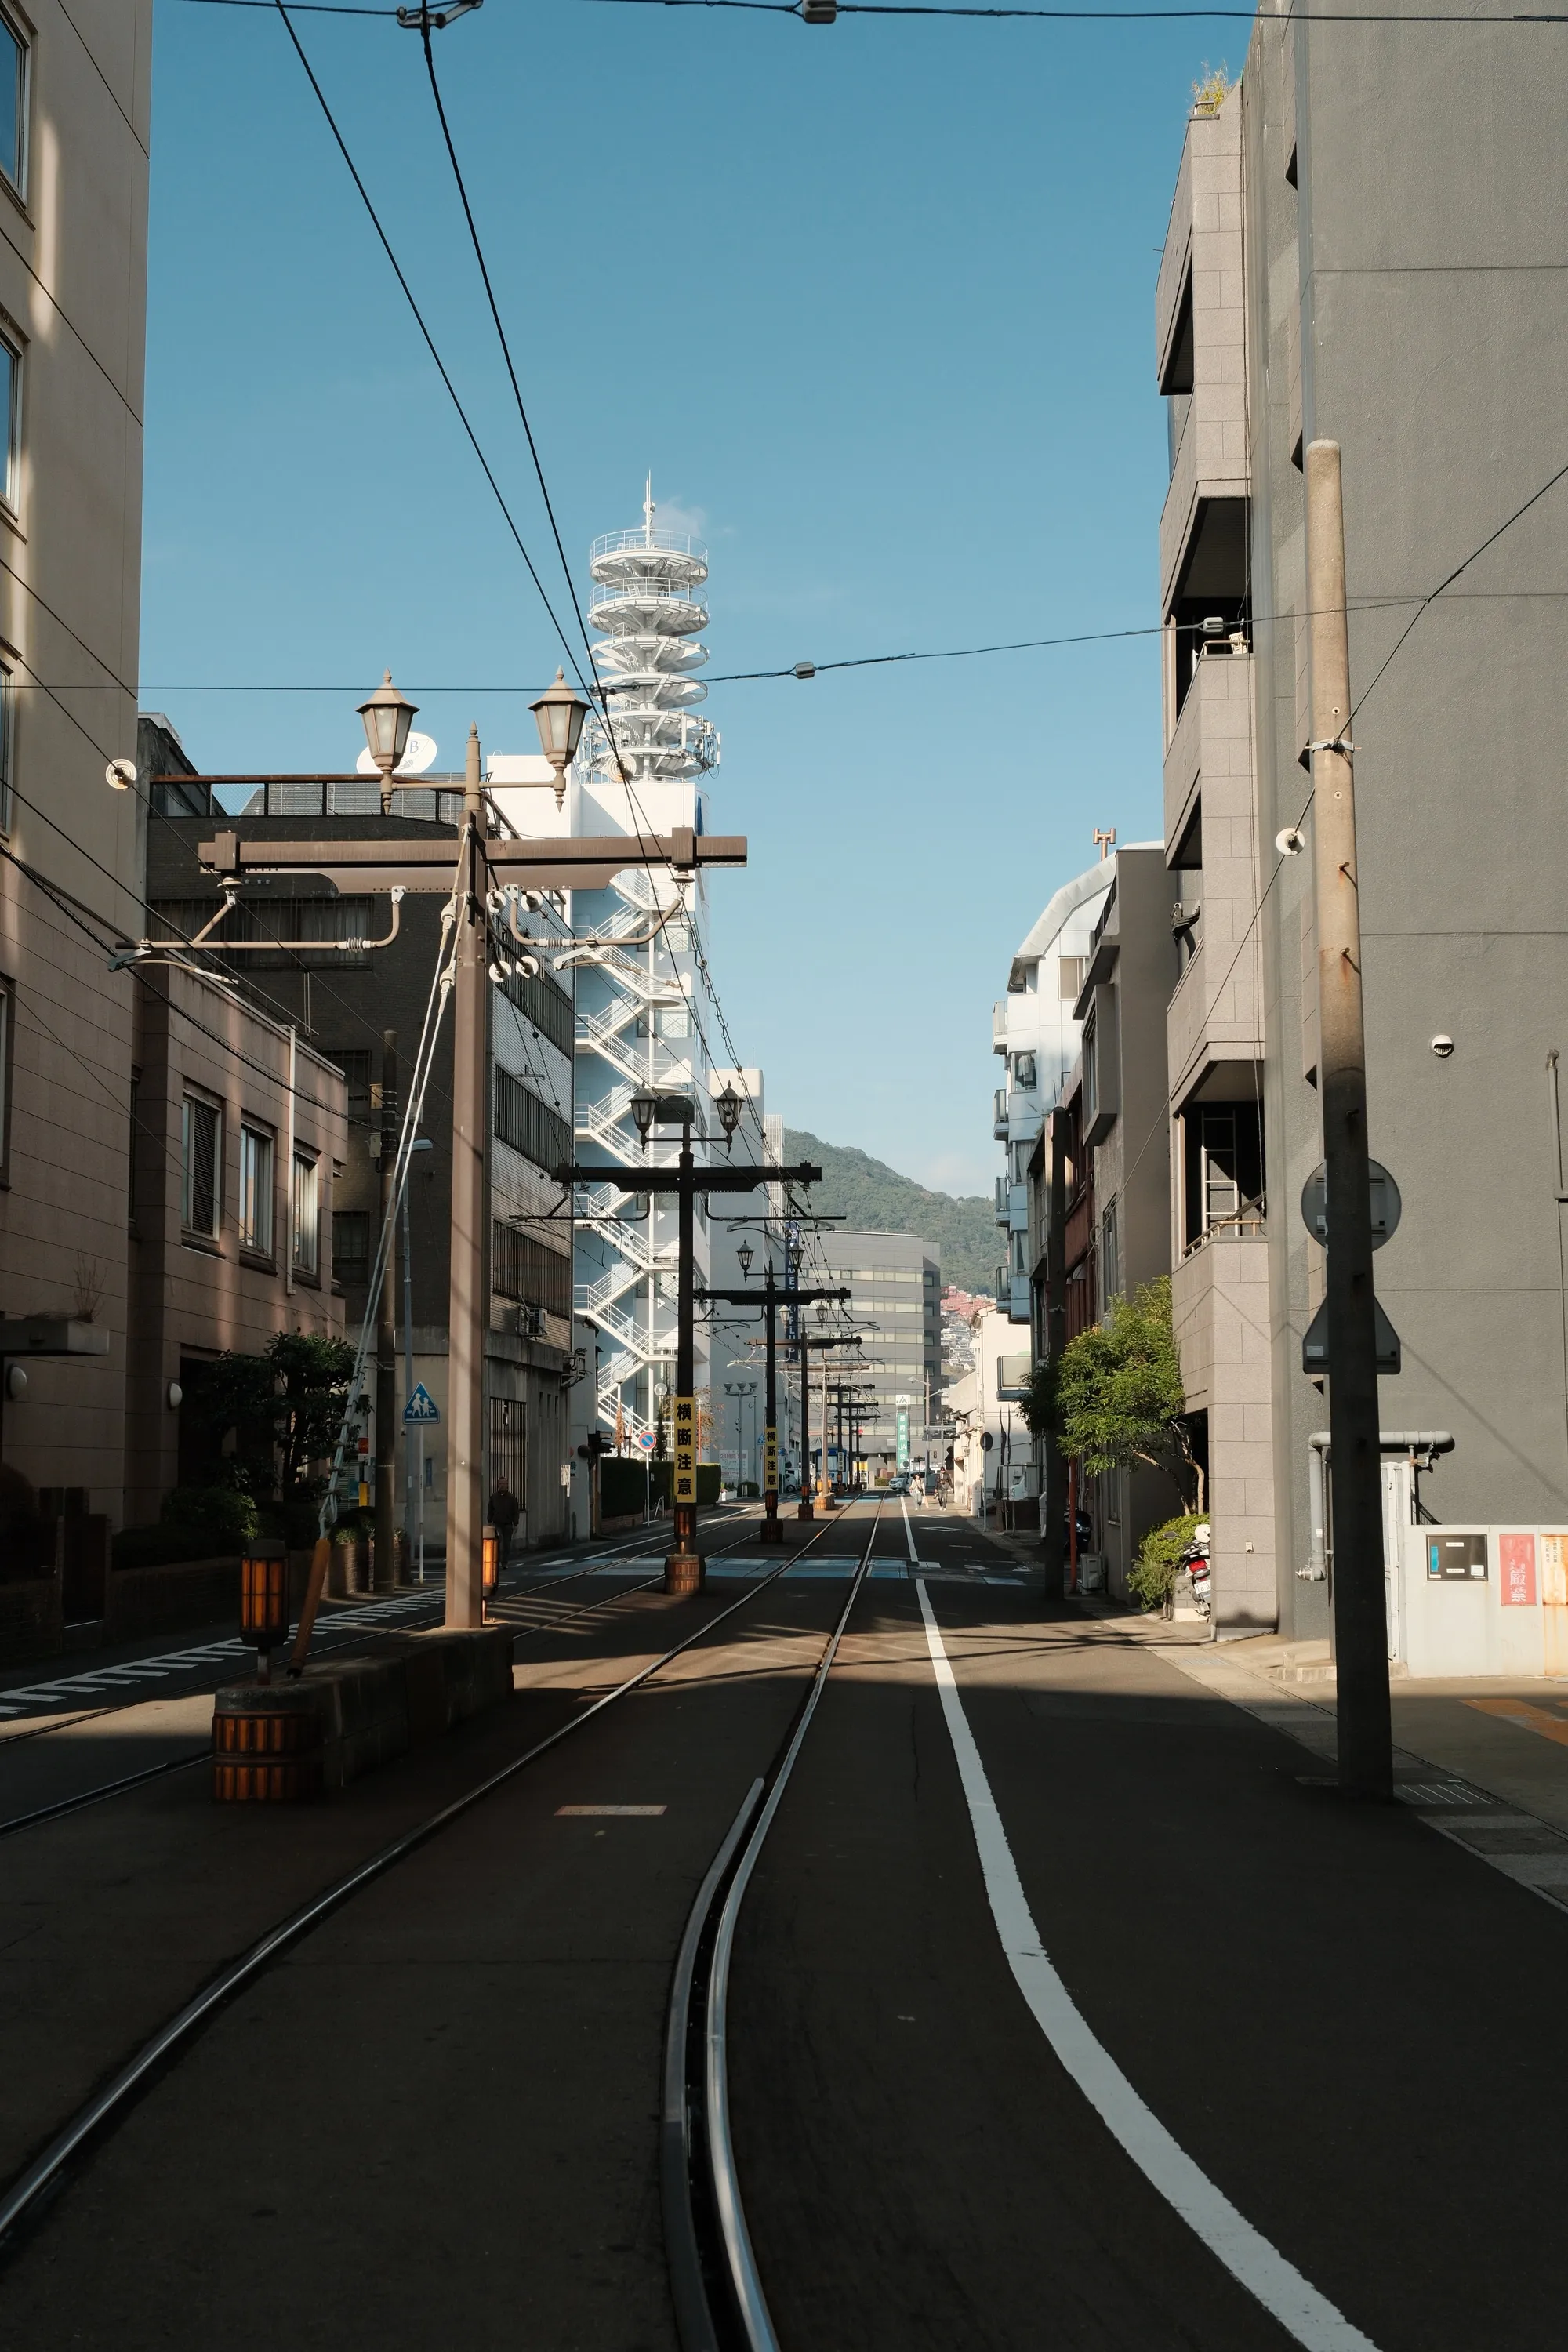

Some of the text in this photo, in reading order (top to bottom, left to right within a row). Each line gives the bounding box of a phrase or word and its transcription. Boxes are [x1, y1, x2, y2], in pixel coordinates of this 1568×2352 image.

[677, 1403, 692, 1495] 横断注意
[767, 1431, 776, 1486] 横断注意
